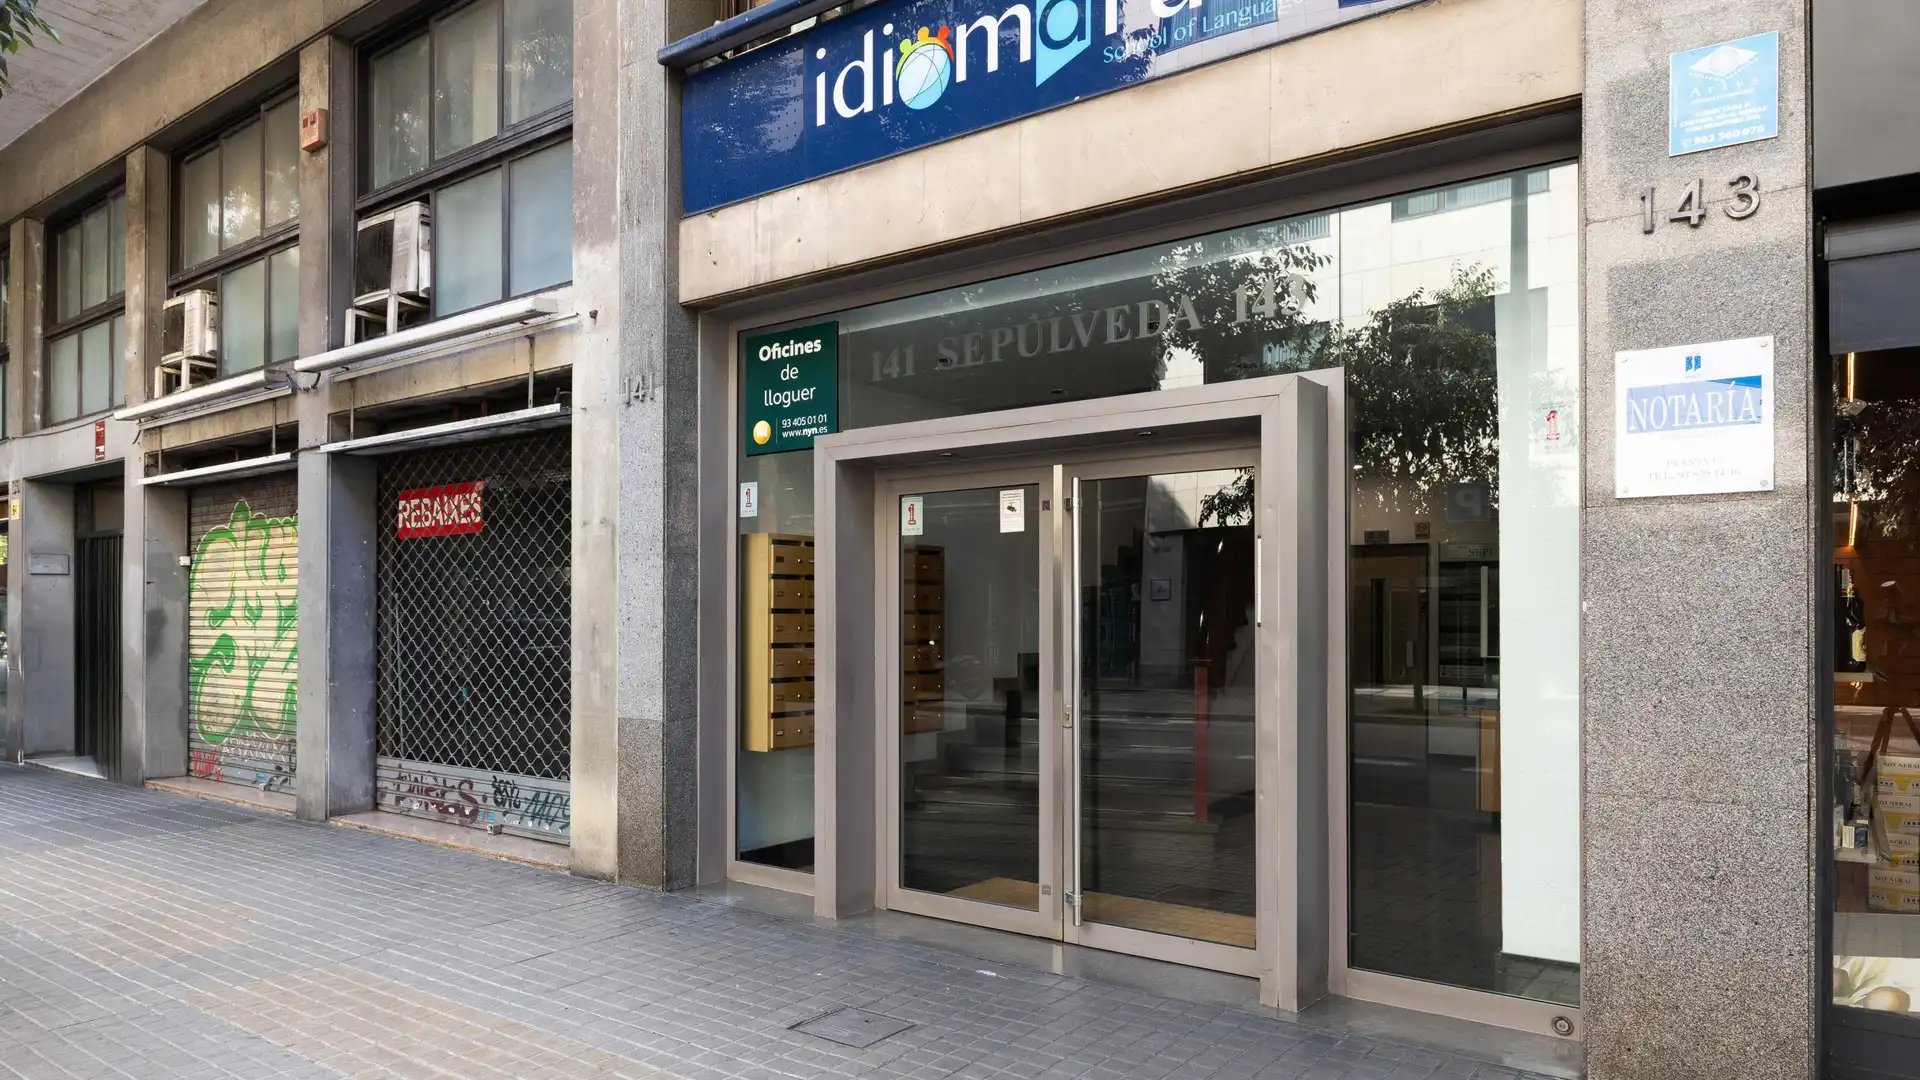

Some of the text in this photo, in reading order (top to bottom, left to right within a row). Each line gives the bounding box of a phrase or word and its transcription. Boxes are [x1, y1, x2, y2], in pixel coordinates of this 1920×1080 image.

[1173, 17, 1198, 42] of
[1640, 173, 1760, 234] 143
[871, 343, 917, 382] 141
[1231, 272, 1308, 326] 143
[758, 339, 822, 362] Oficines
[780, 363, 799, 381] de
[624, 372, 656, 406] 141
[764, 387, 817, 408] lloguer
[1628, 380, 1758, 431] NOTARÍA
[782, 413, 828, 429] 93 405 01 01
[782, 425, 828, 438] www.nyn.es
[398, 492, 482, 529] REBAIXES
